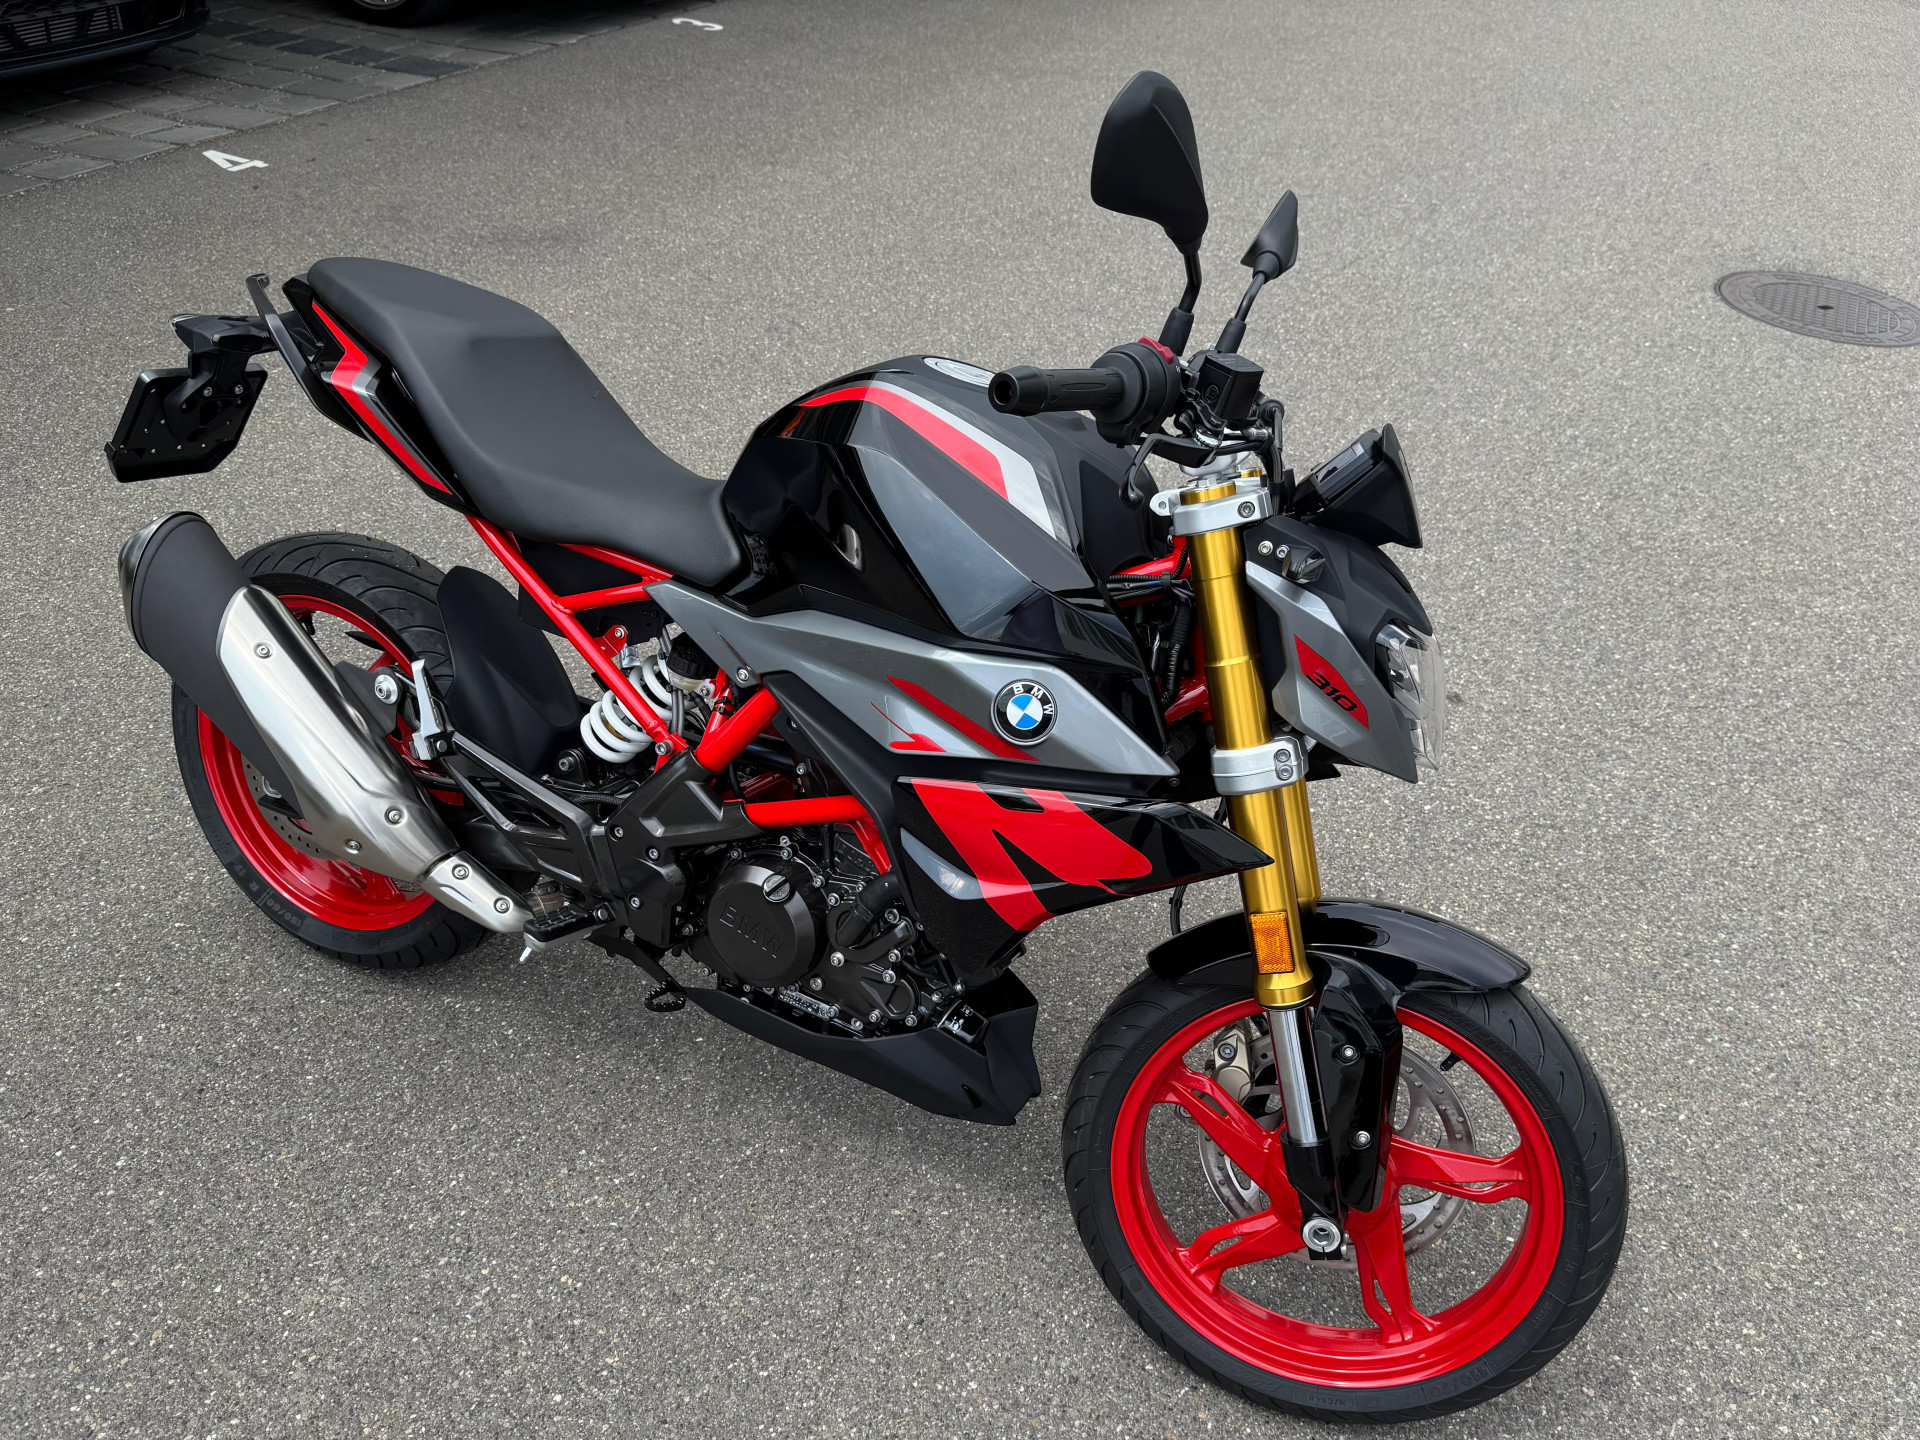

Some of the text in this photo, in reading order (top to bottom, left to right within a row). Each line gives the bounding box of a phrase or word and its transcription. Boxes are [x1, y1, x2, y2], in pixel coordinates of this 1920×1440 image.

[672, 17, 724, 31] 3
[201, 149, 269, 172] 4
[1012, 683, 1054, 715] BMW
[1305, 671, 1358, 711] 310
[719, 901, 785, 959] BMW
